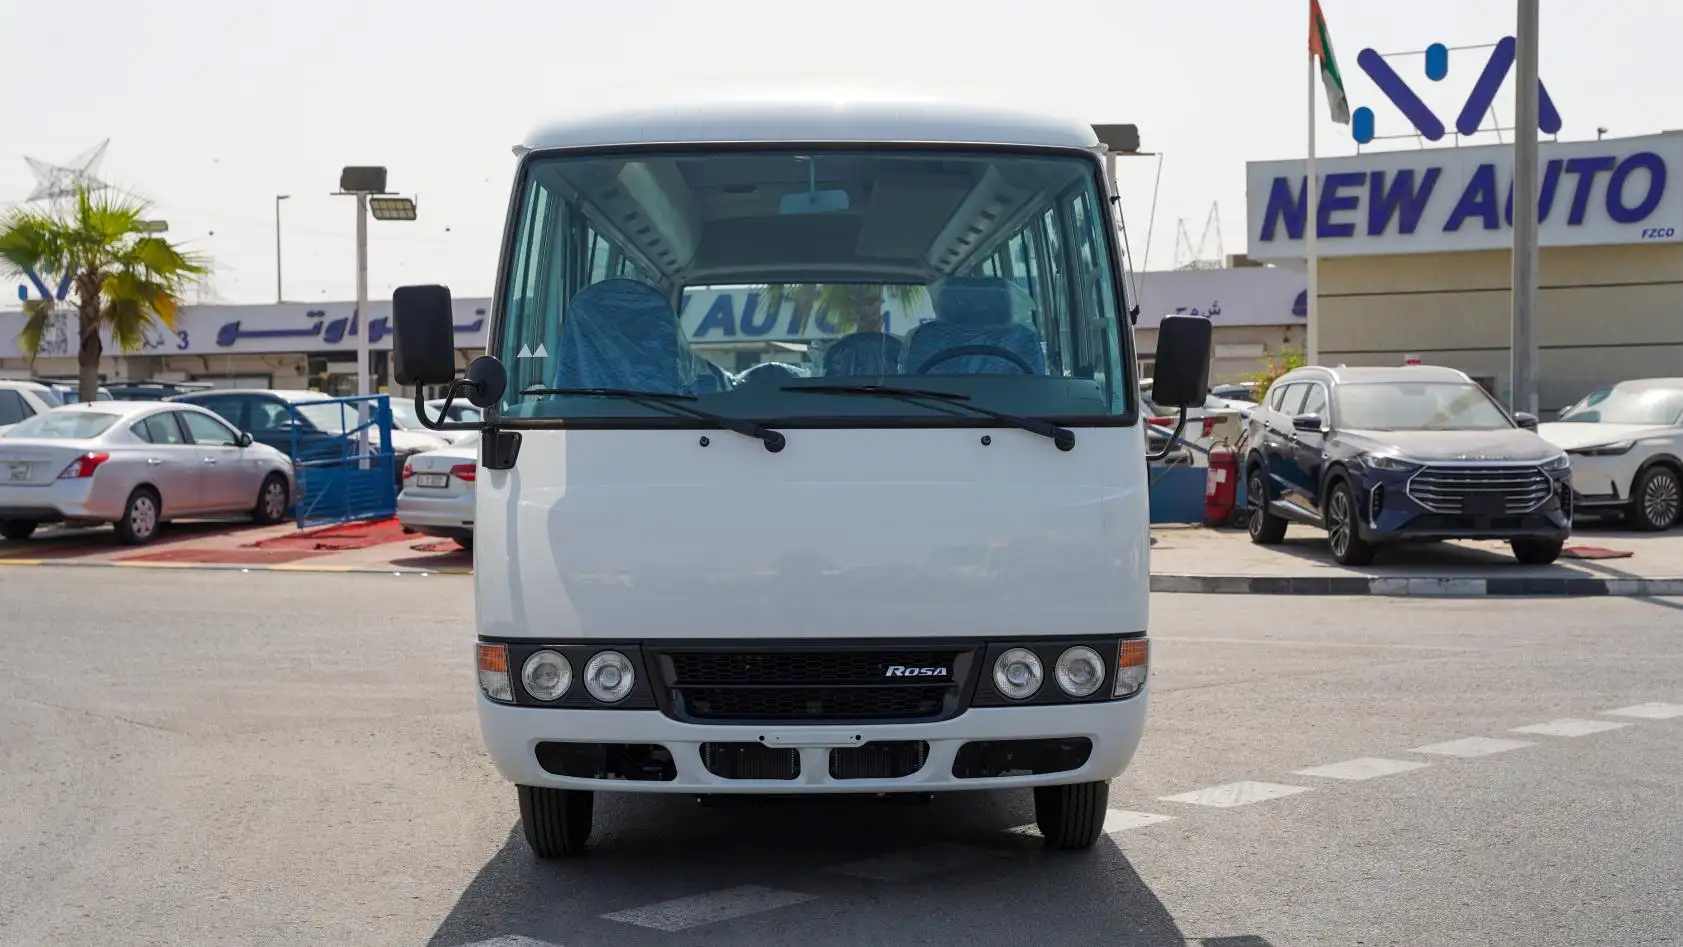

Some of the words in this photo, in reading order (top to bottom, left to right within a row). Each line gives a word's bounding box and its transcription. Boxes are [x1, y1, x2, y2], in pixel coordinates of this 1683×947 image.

[1259, 167, 1442, 242] NEW
[1442, 151, 1667, 232] AUTO
[1641, 227, 1675, 239] FZCO
[176, 329, 189, 350] 3
[885, 665, 948, 677] ROSA
